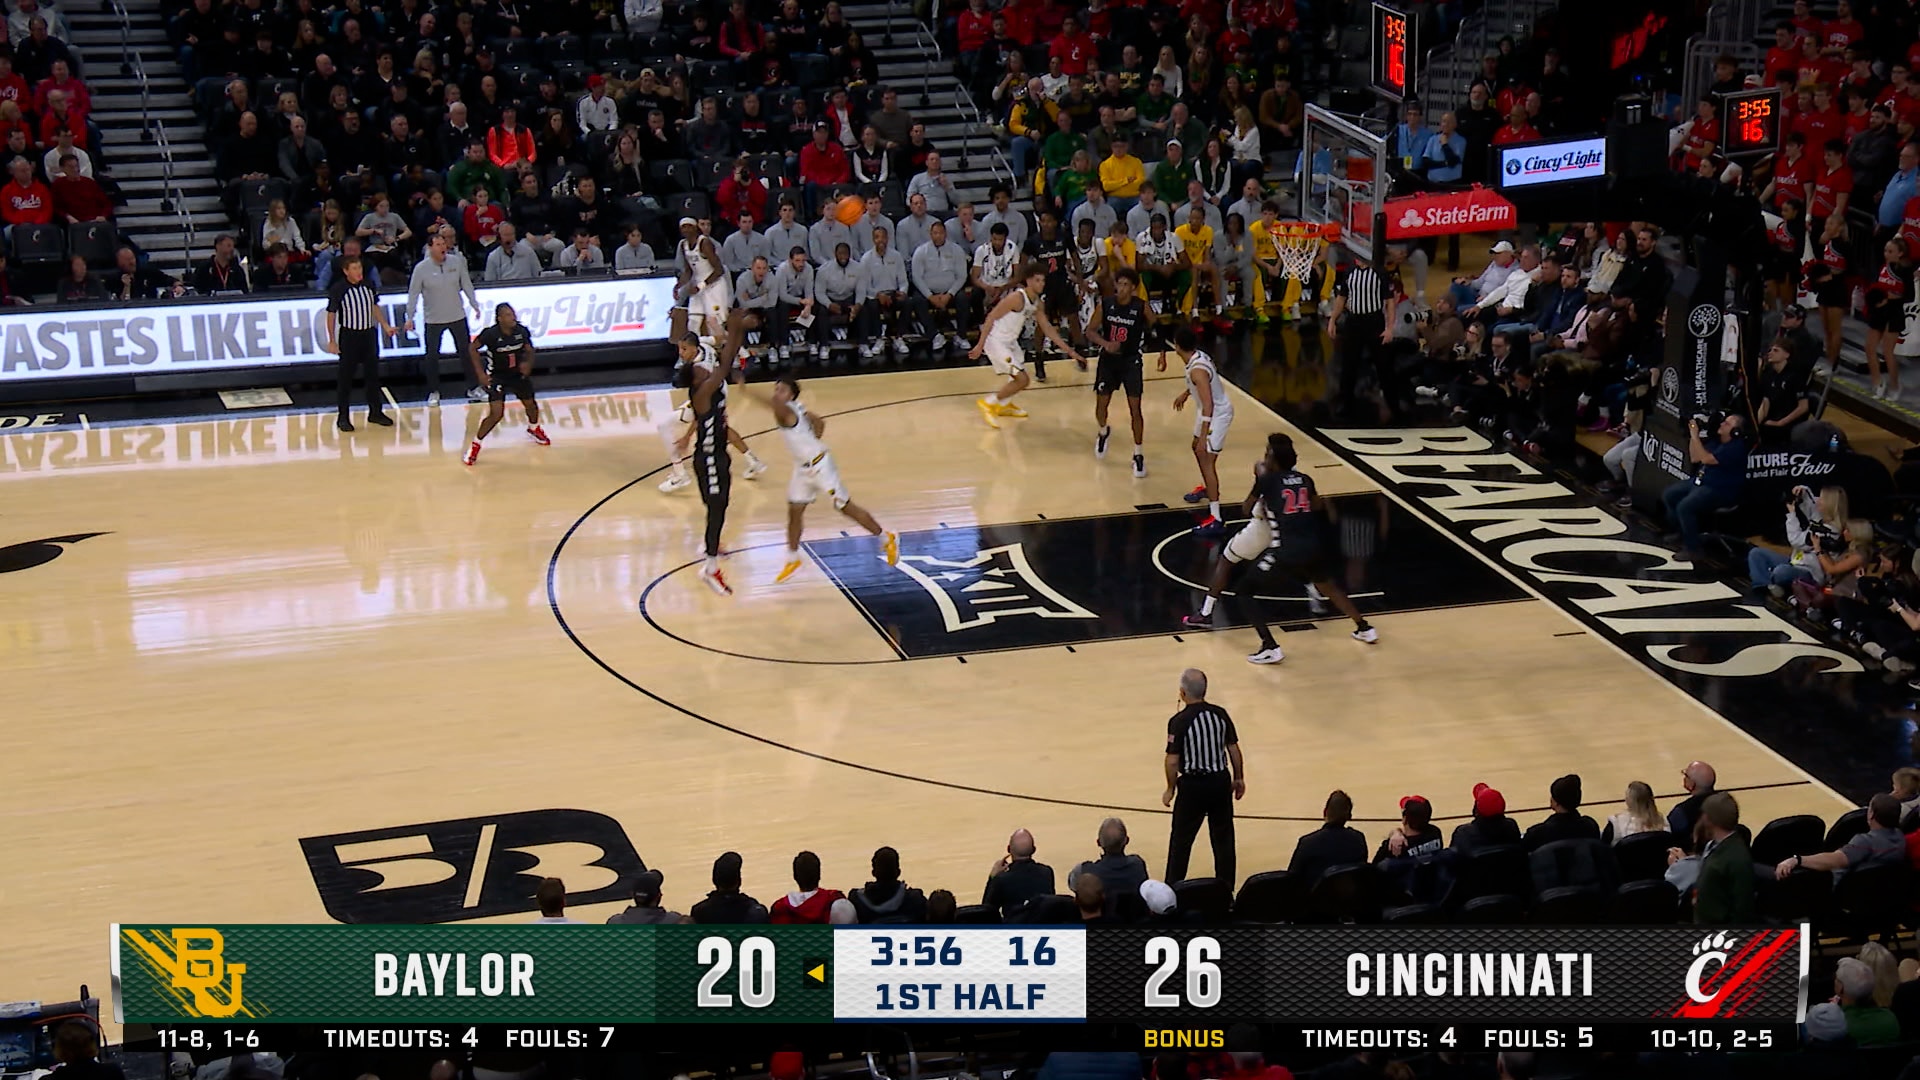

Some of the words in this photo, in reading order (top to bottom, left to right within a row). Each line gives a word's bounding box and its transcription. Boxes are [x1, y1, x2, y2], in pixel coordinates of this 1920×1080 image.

[1739, 98, 1771, 119] 3:55
[1743, 119, 1763, 141] 16
[1524, 157, 1562, 173] Cincy
[1563, 150, 1602, 169] Light
[11, 194, 42, 210] Reds
[1425, 207, 1467, 226] State
[1468, 203, 1509, 222] Farm
[554, 292, 650, 335] Light
[0, 316, 158, 373] ASTES
[166, 310, 272, 363] LIKE
[1110, 325, 1128, 342] 18
[1752, 470, 1768, 479] and
[1789, 453, 1836, 477] Fair
[1281, 487, 1312, 514] 24
[1315, 425, 1866, 677] BEARCATS
